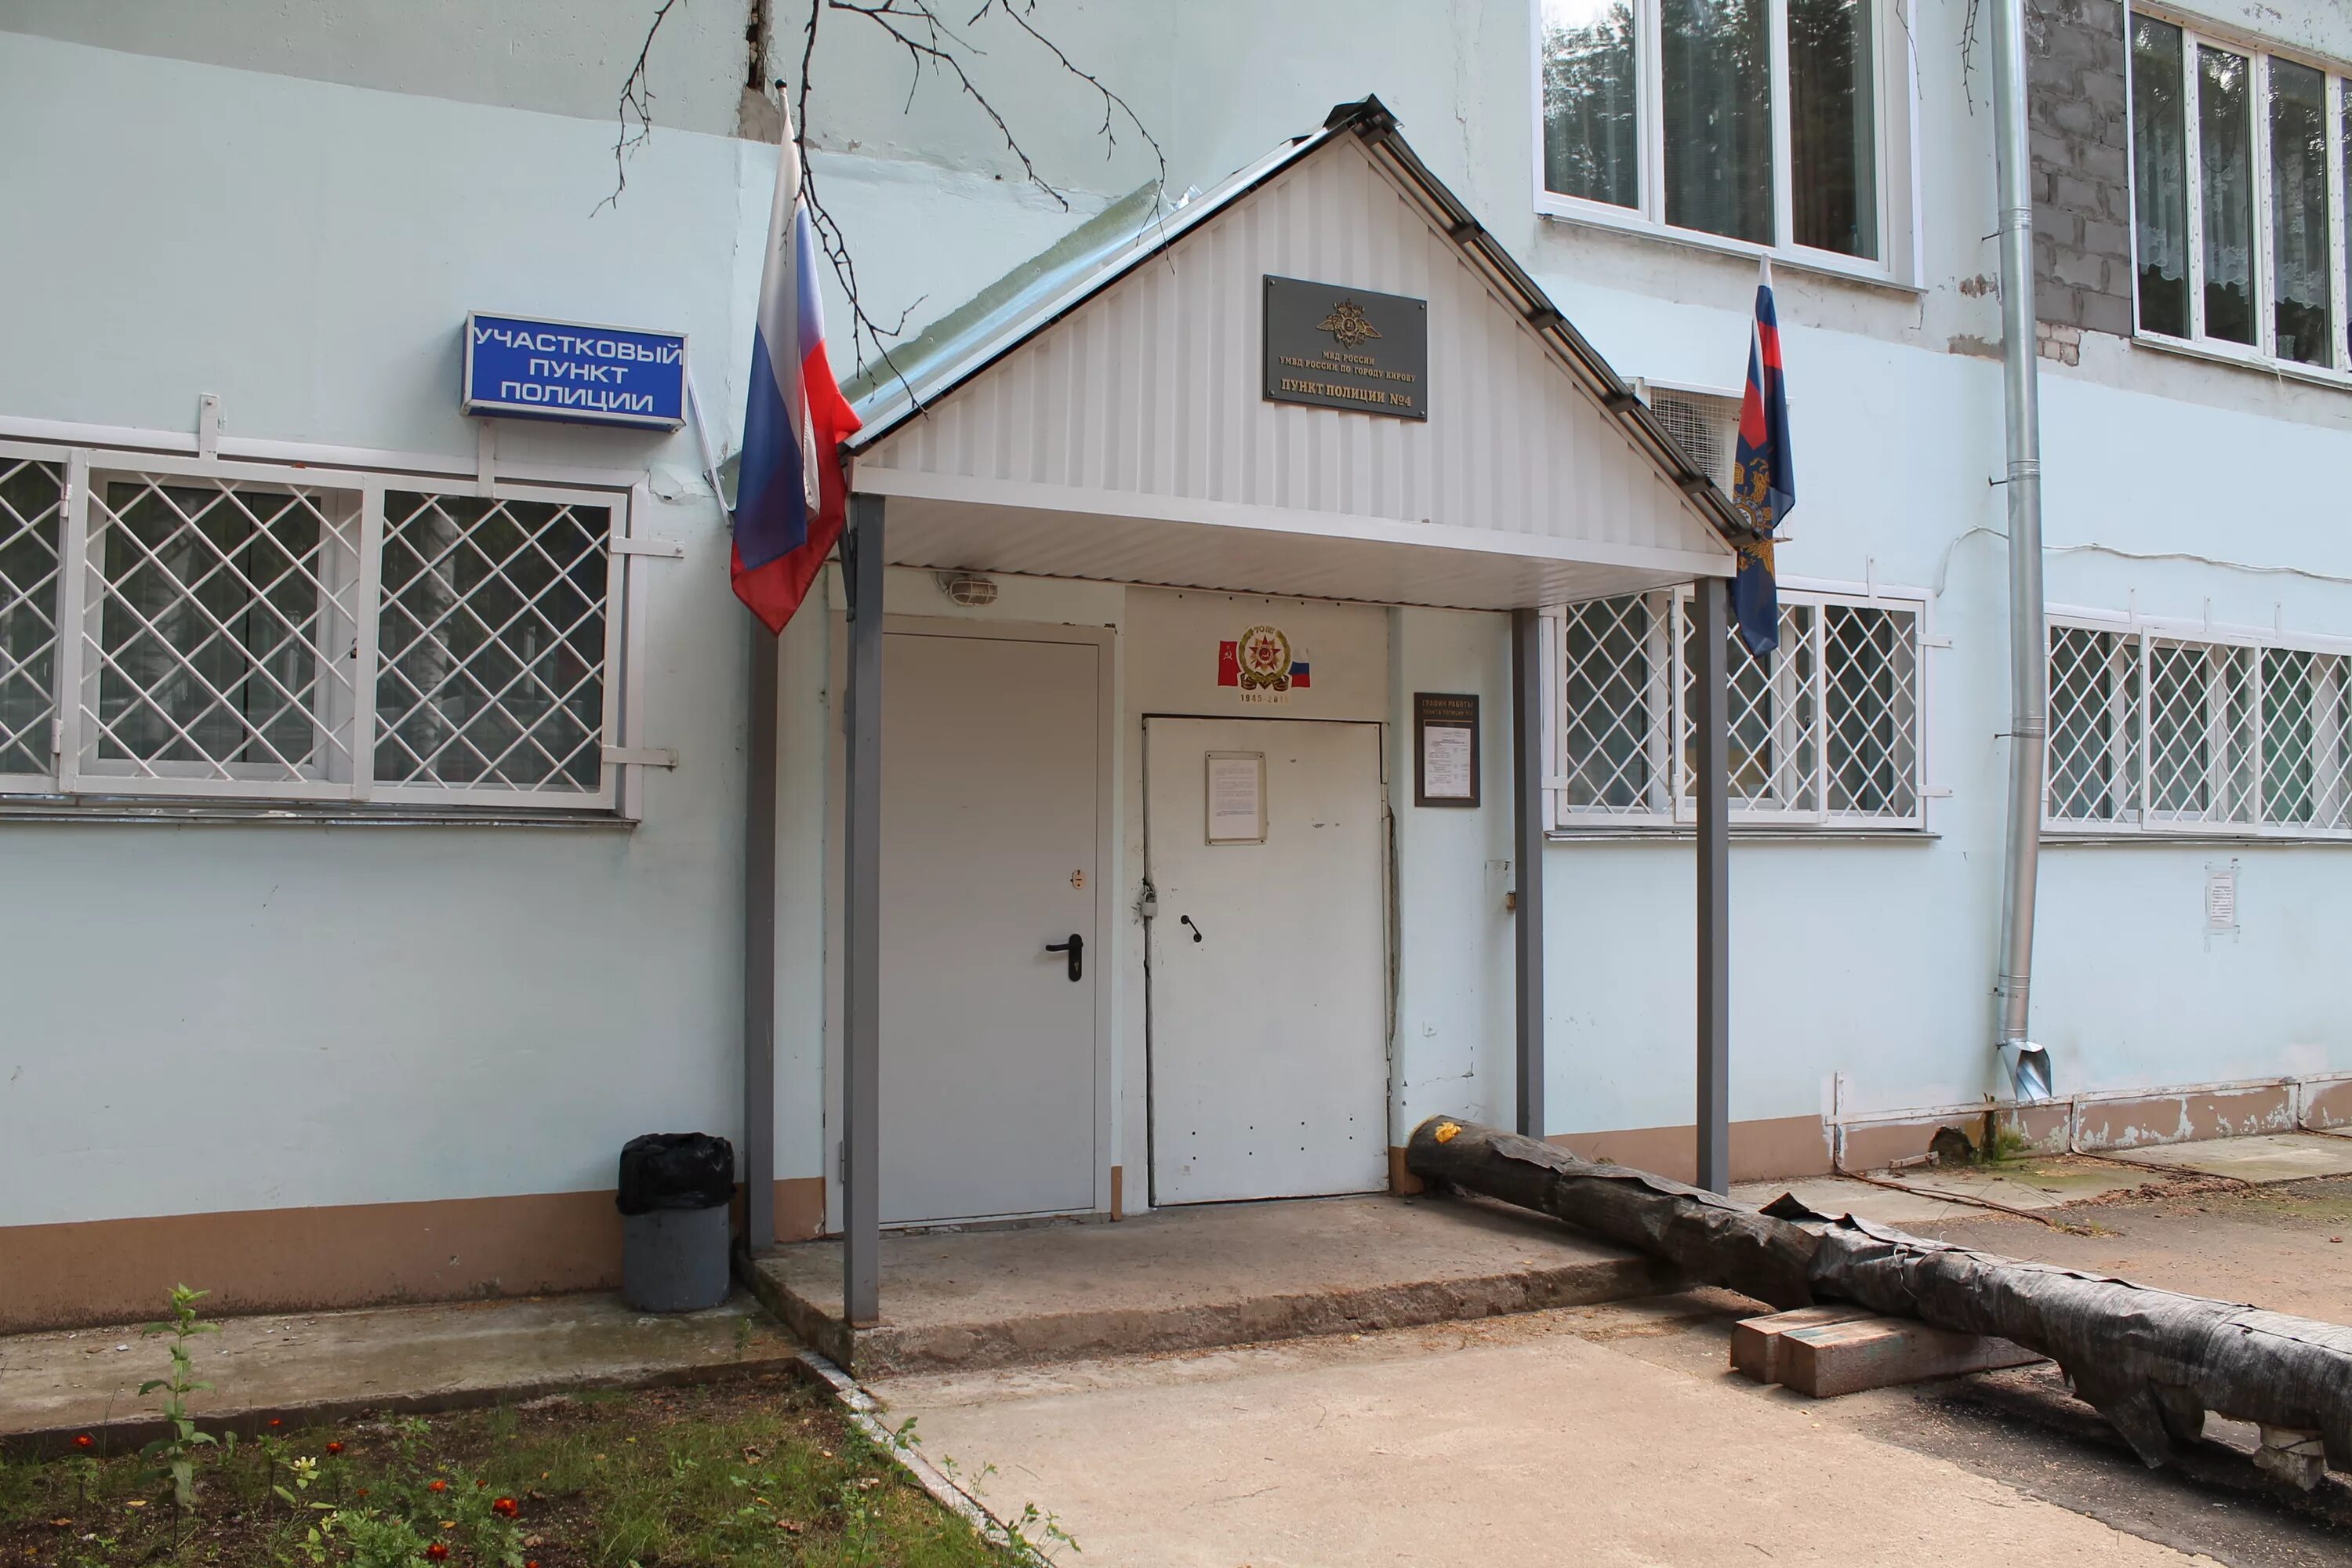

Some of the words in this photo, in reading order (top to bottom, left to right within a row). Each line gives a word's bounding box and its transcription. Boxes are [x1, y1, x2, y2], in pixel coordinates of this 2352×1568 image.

[474, 327, 683, 365] УЧАСТКОВЫЙ
[1323, 351, 1340, 361] МВД
[1343, 354, 1374, 365] РОССИИ
[529, 358, 629, 384] ПУНКТ
[1279, 356, 1303, 368] УМВД
[1305, 360, 1338, 372] РОССИИ
[1340, 365, 1351, 373] ПО
[1354, 366, 1384, 378] ГОРОДУ
[1386, 371, 1416, 383] КИРОВУ
[501, 381, 653, 412] ПОЛИЦИИ
[1281, 378, 1324, 394] ПУНКТ
[1326, 384, 1385, 403] ПОЛИЦИИ
[1389, 393, 1412, 407] №4
[1240, 694, 1289, 703] 1945-201
[1448, 700, 1474, 709] РАБОТЫ
